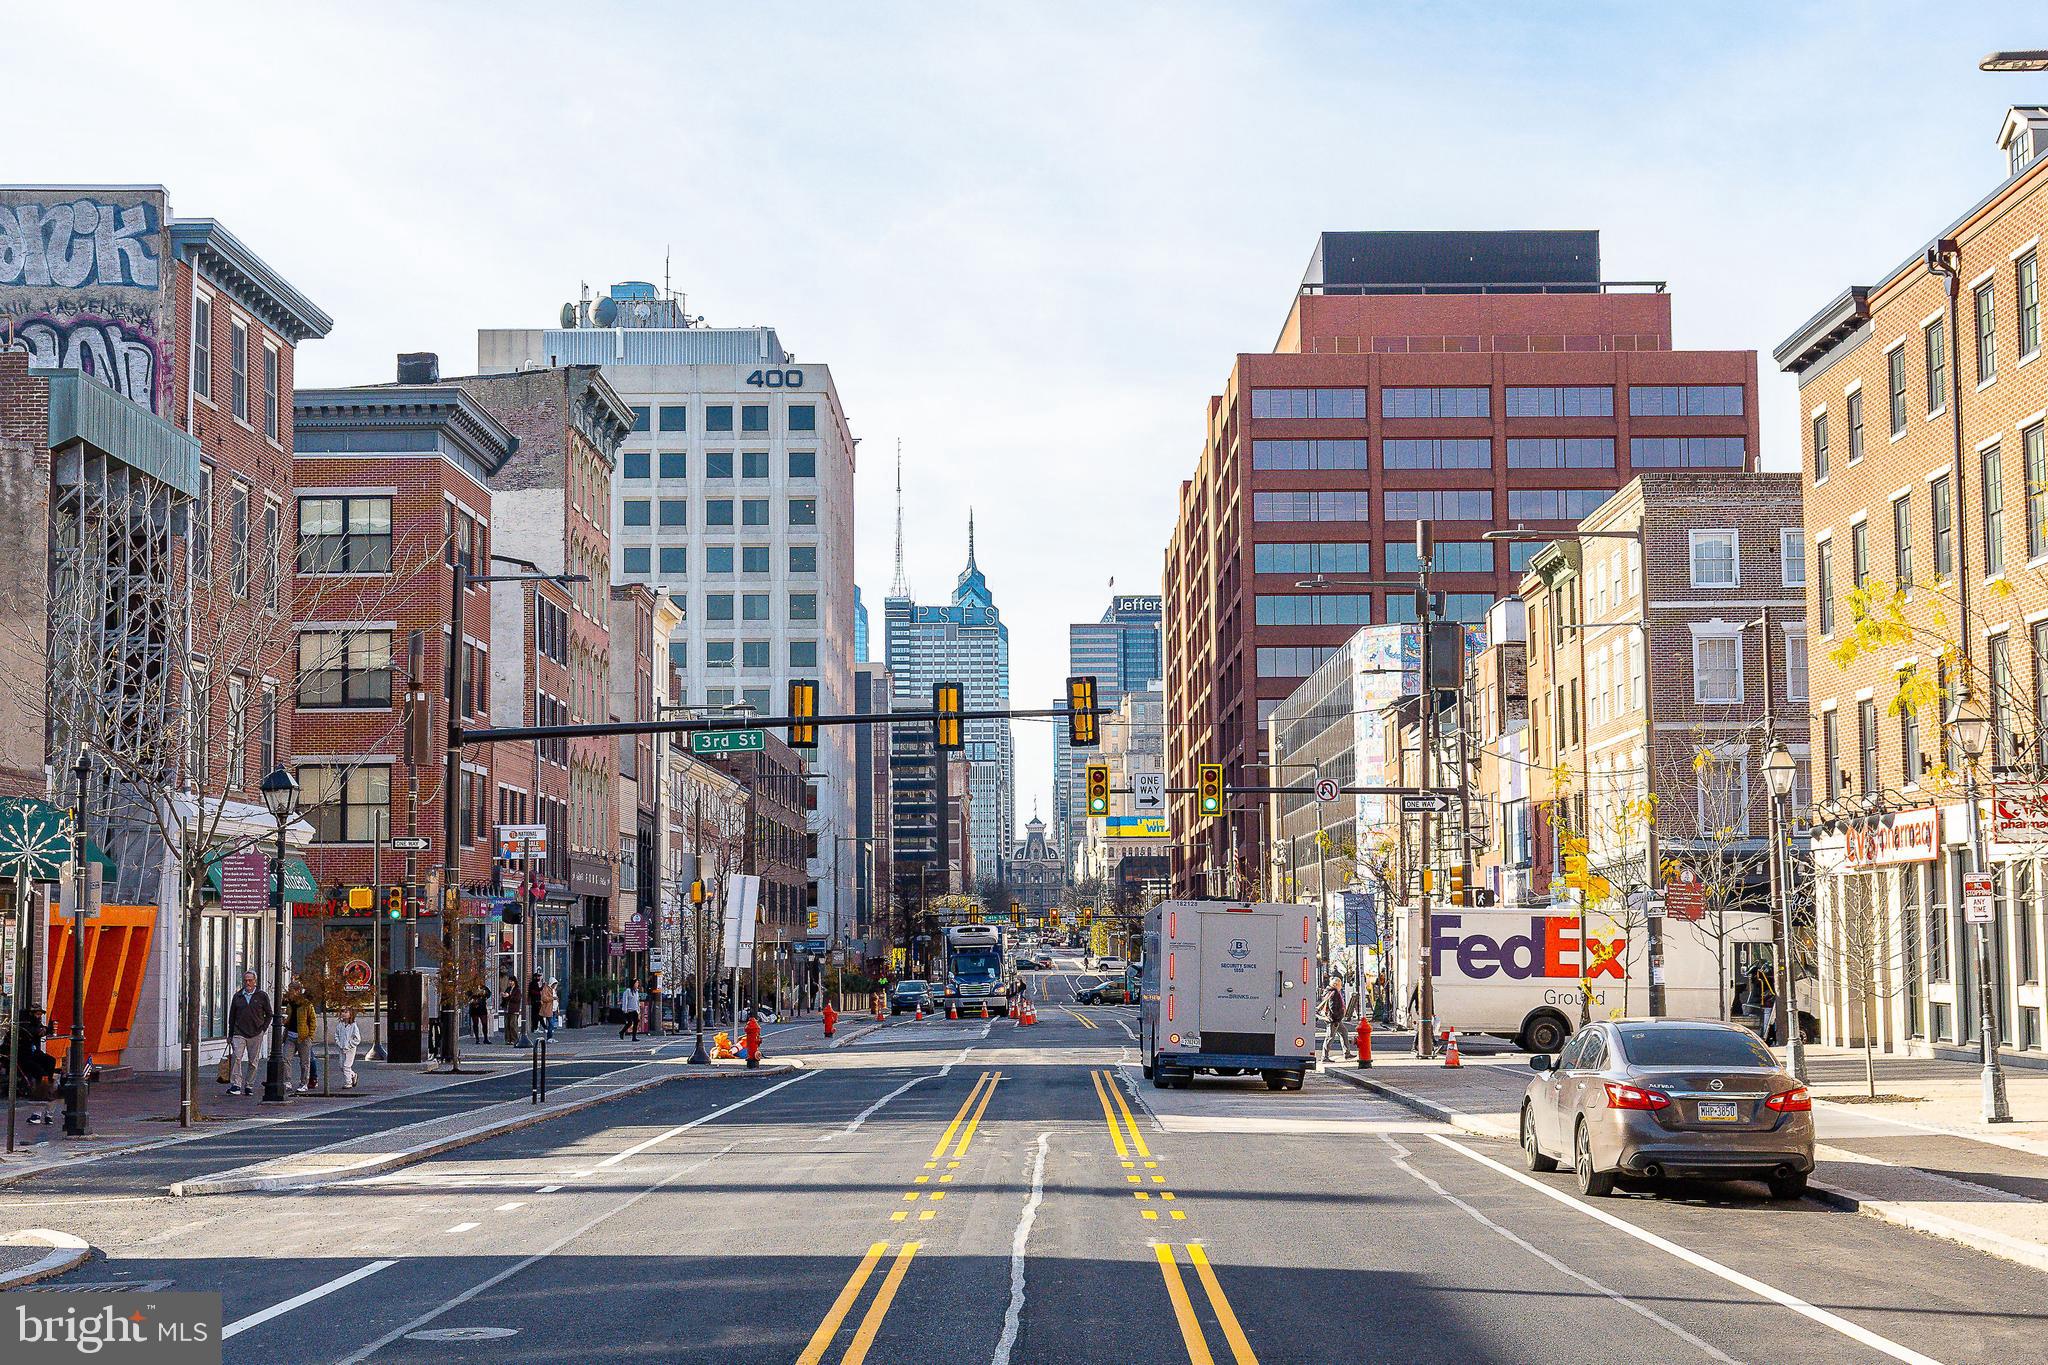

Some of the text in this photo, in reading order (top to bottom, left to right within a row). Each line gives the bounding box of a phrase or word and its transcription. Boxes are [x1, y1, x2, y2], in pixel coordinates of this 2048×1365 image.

[747, 369, 803, 388] 400
[702, 733, 757, 748] 3rd St
[1140, 776, 1159, 785] ONE
[1140, 785, 1160, 795] WAY
[1406, 800, 1436, 808] ONE WAY
[2001, 820, 2048, 831] pharma
[1973, 905, 1987, 913] TIME
[1431, 915, 1632, 980] FedEx
